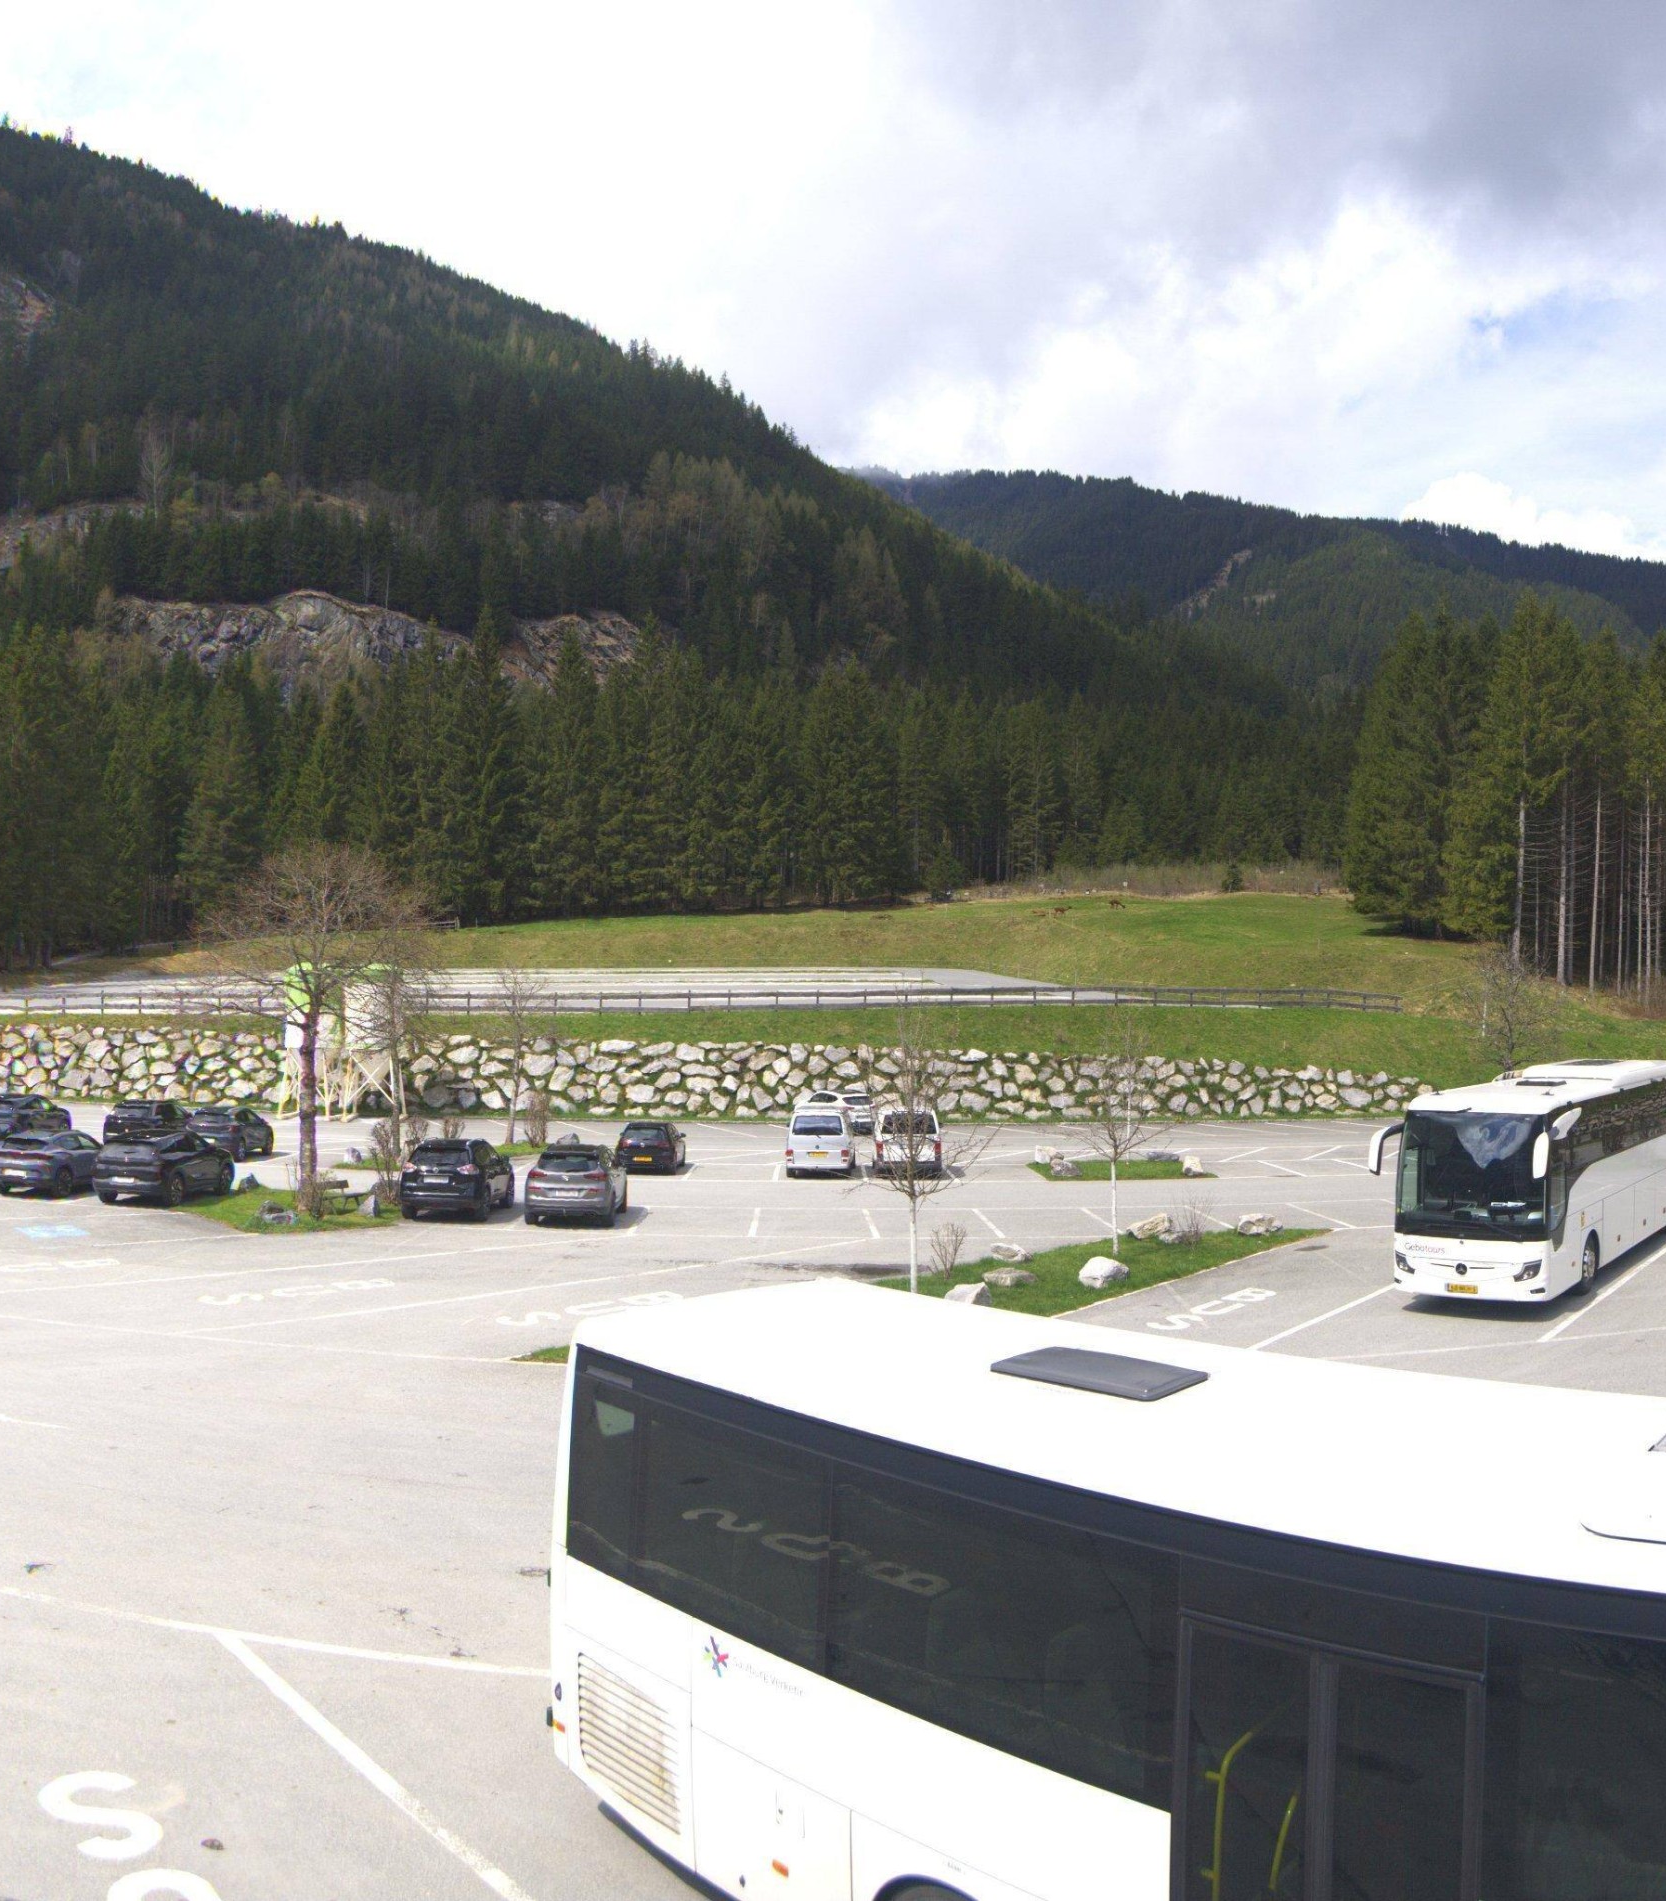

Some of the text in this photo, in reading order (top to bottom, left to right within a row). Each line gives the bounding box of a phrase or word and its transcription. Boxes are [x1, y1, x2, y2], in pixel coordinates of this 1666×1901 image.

[196, 1278, 395, 1306] BUS
[495, 1291, 684, 1327] BUS
[1146, 1287, 1277, 1331] BUS
